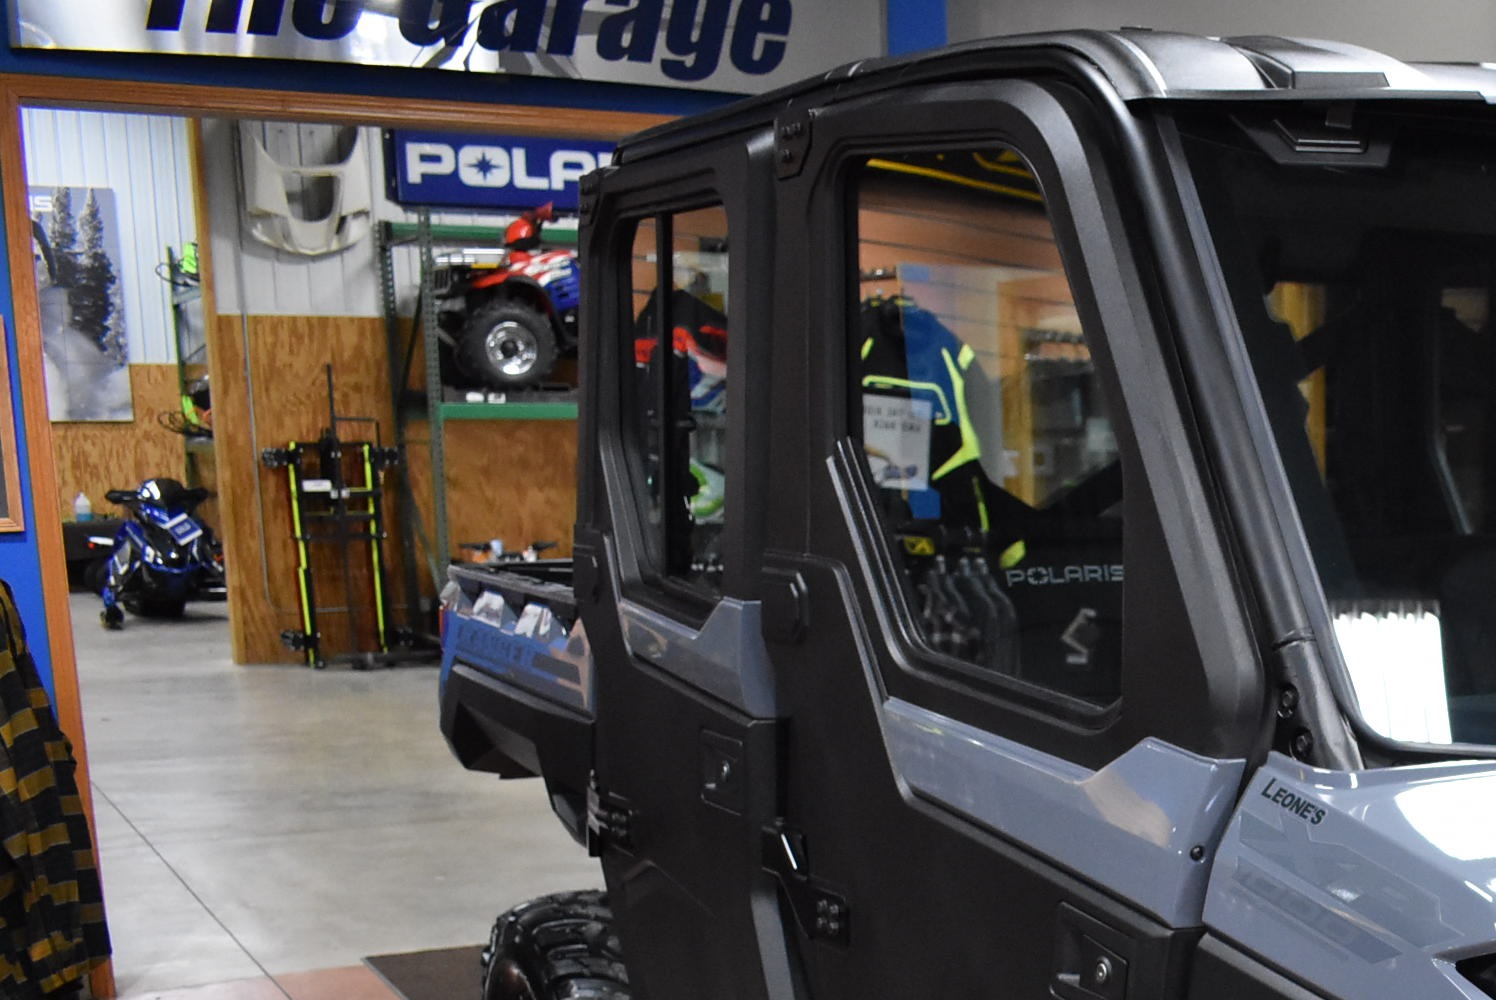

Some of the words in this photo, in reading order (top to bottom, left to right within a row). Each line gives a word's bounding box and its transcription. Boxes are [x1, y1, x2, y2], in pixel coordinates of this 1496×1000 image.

[405, 142, 613, 191] POLA
[1005, 564, 1124, 587] POLARIS
[1261, 777, 1327, 826] LEONE'S
